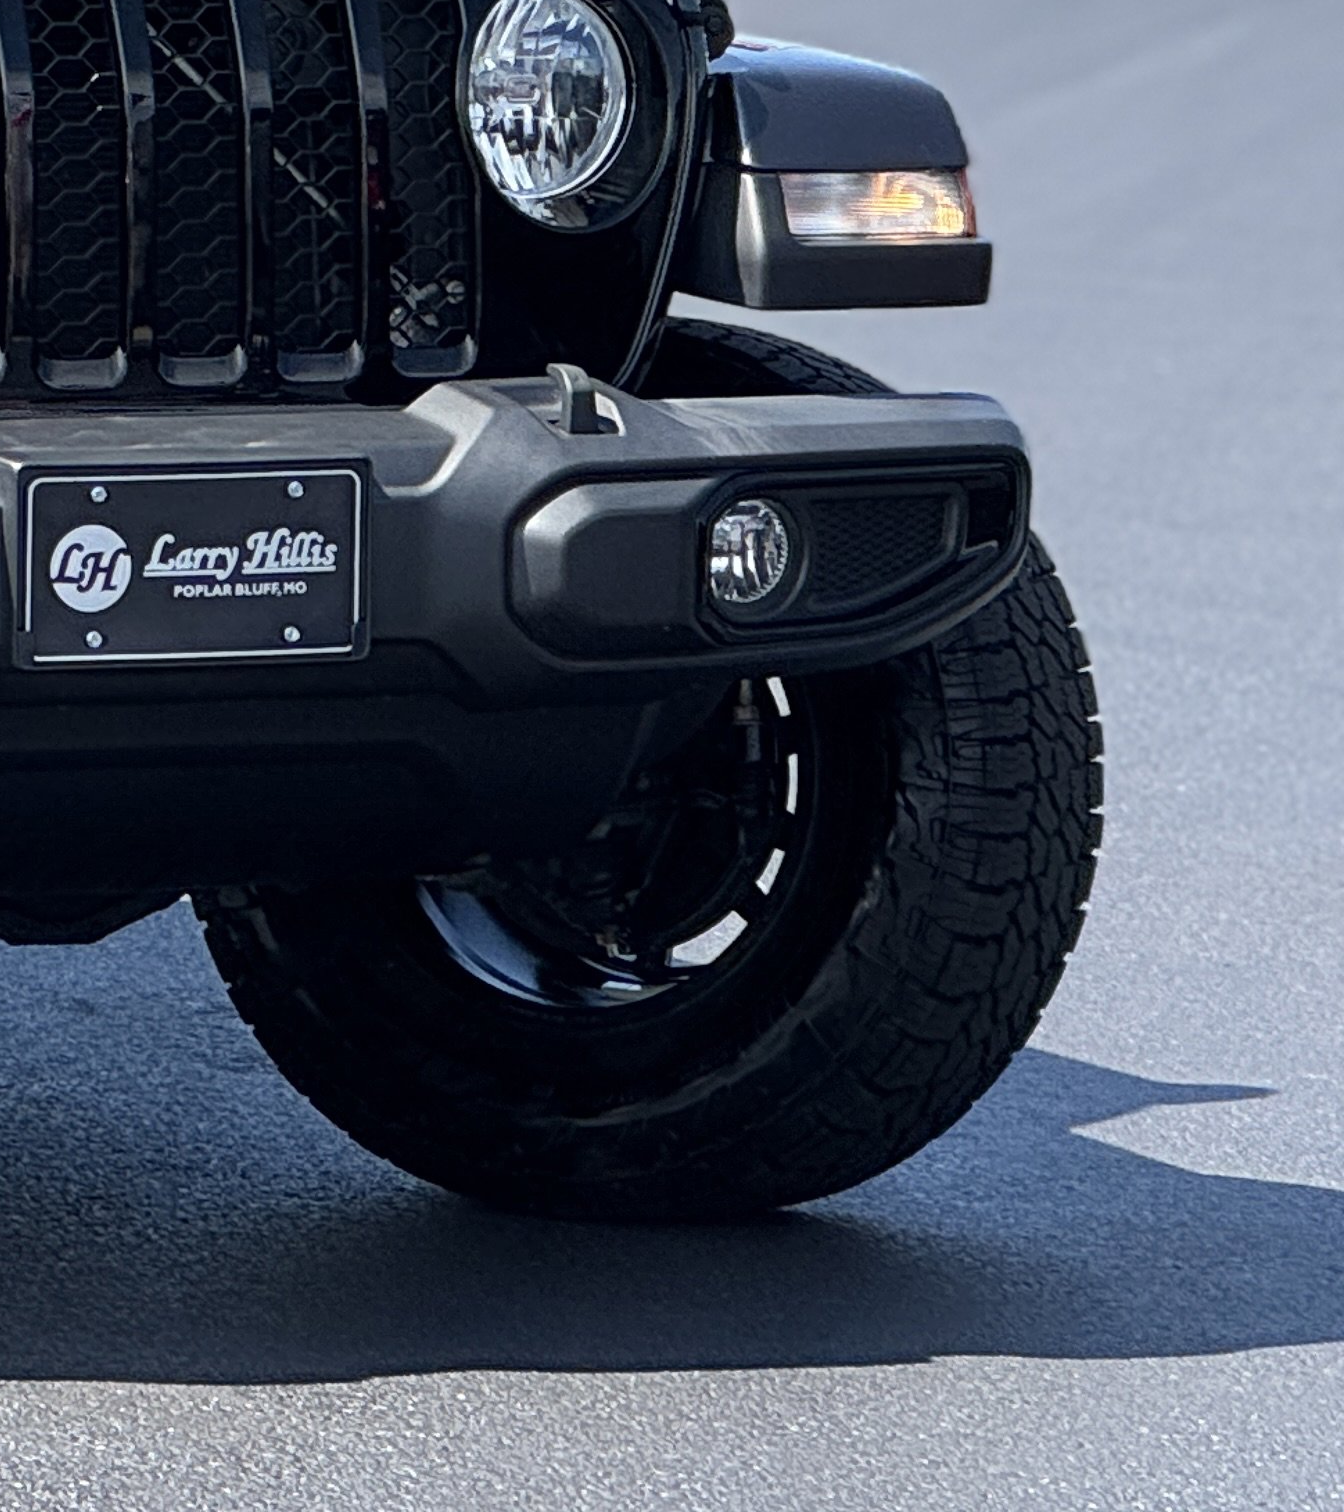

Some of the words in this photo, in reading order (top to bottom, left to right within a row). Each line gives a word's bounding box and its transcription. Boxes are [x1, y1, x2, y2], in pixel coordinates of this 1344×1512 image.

[143, 533, 240, 580] Larry
[242, 528, 338, 571] Hillis
[173, 584, 233, 599] POPLAR
